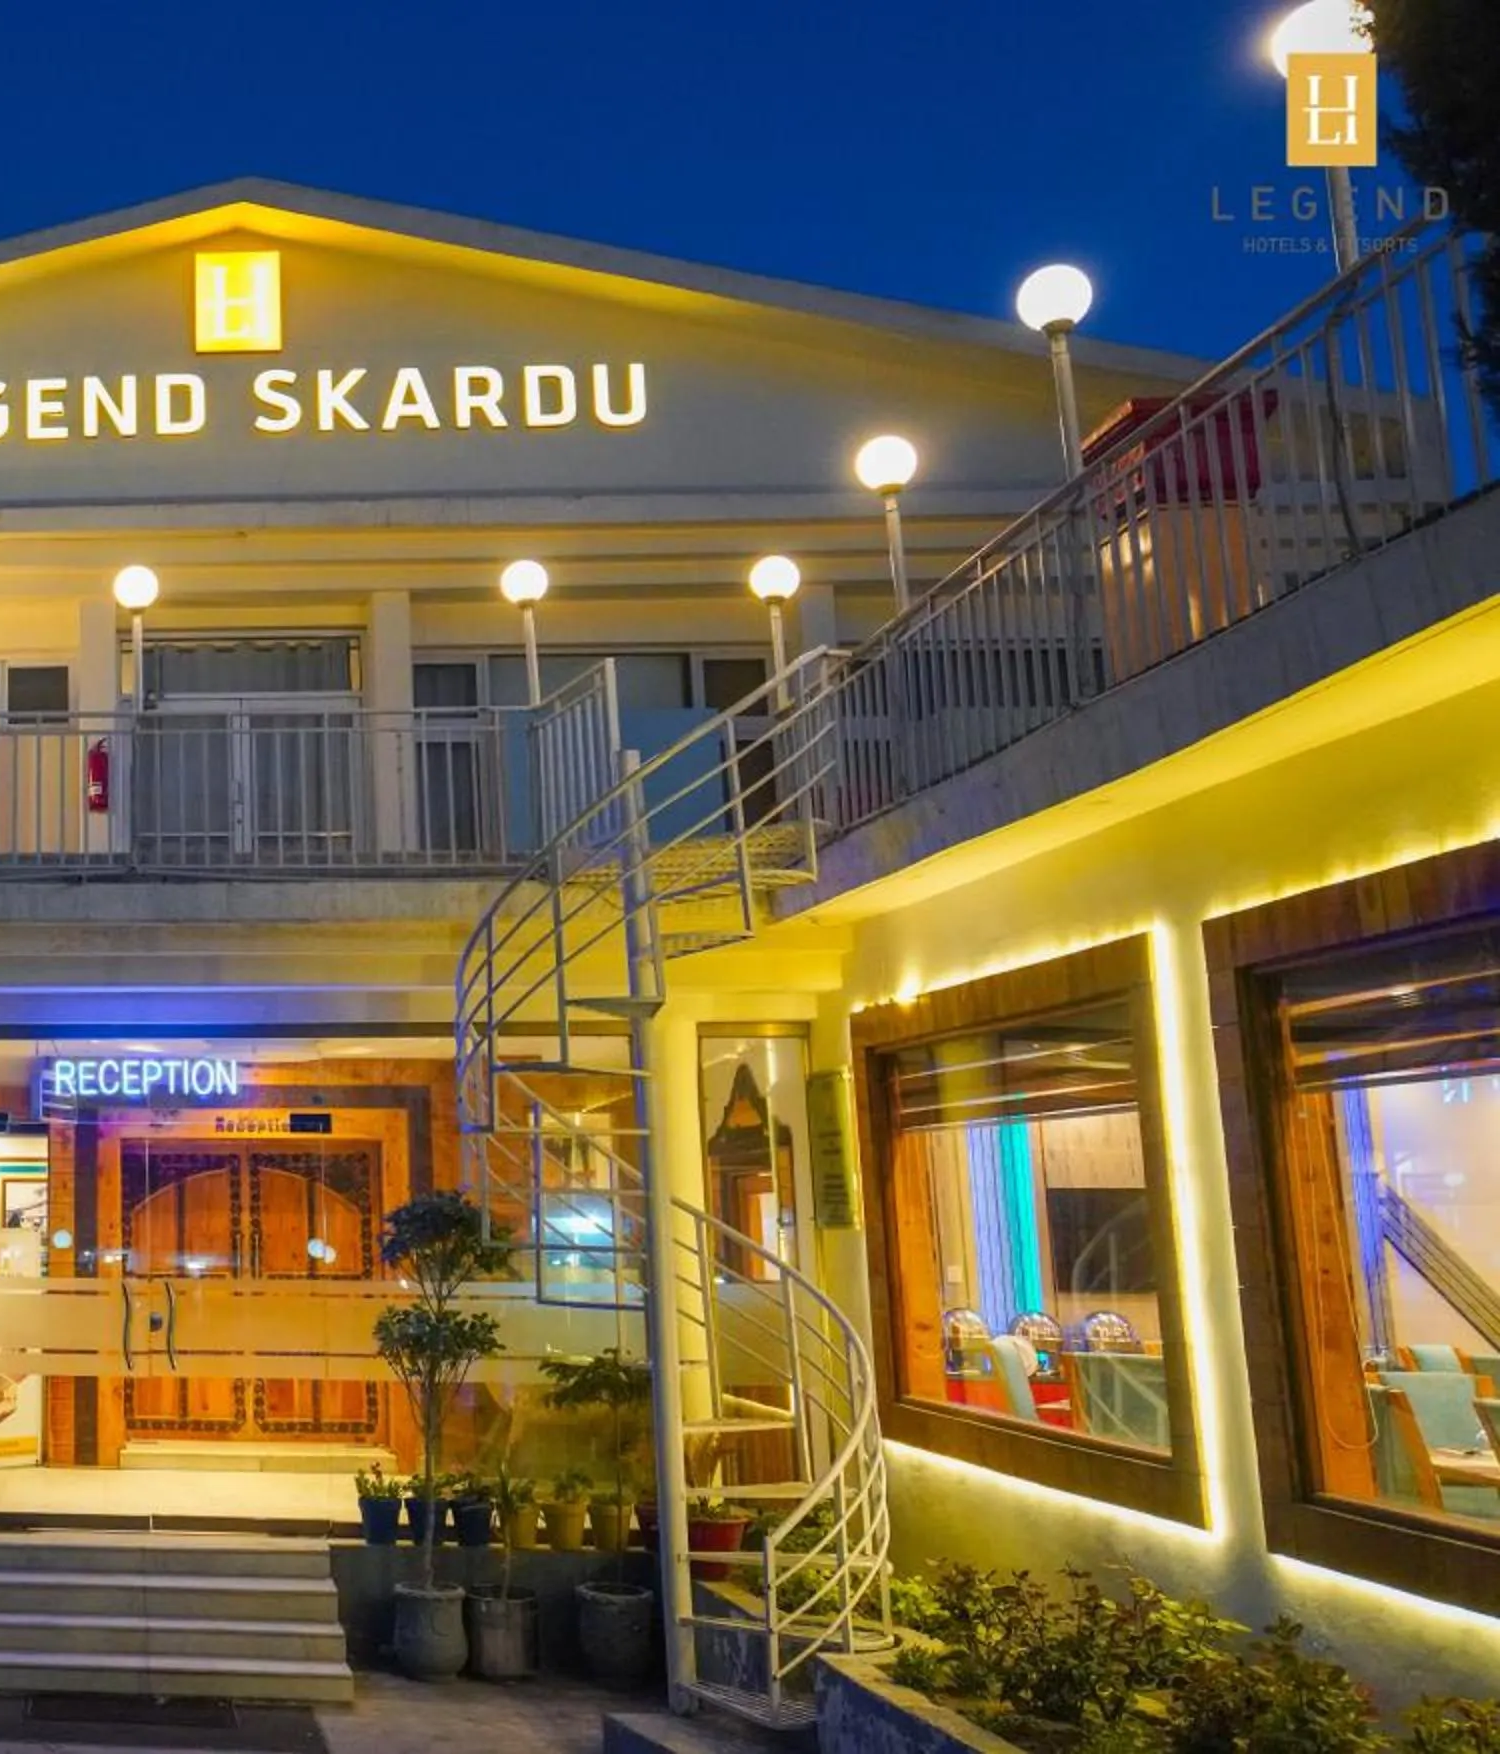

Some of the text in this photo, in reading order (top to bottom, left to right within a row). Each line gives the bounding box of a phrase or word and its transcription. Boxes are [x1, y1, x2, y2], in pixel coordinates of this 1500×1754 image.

[254, 364, 648, 432] SKARDU
[54, 1059, 238, 1096] RECEPTION
[215, 1116, 293, 1133] Receptio
